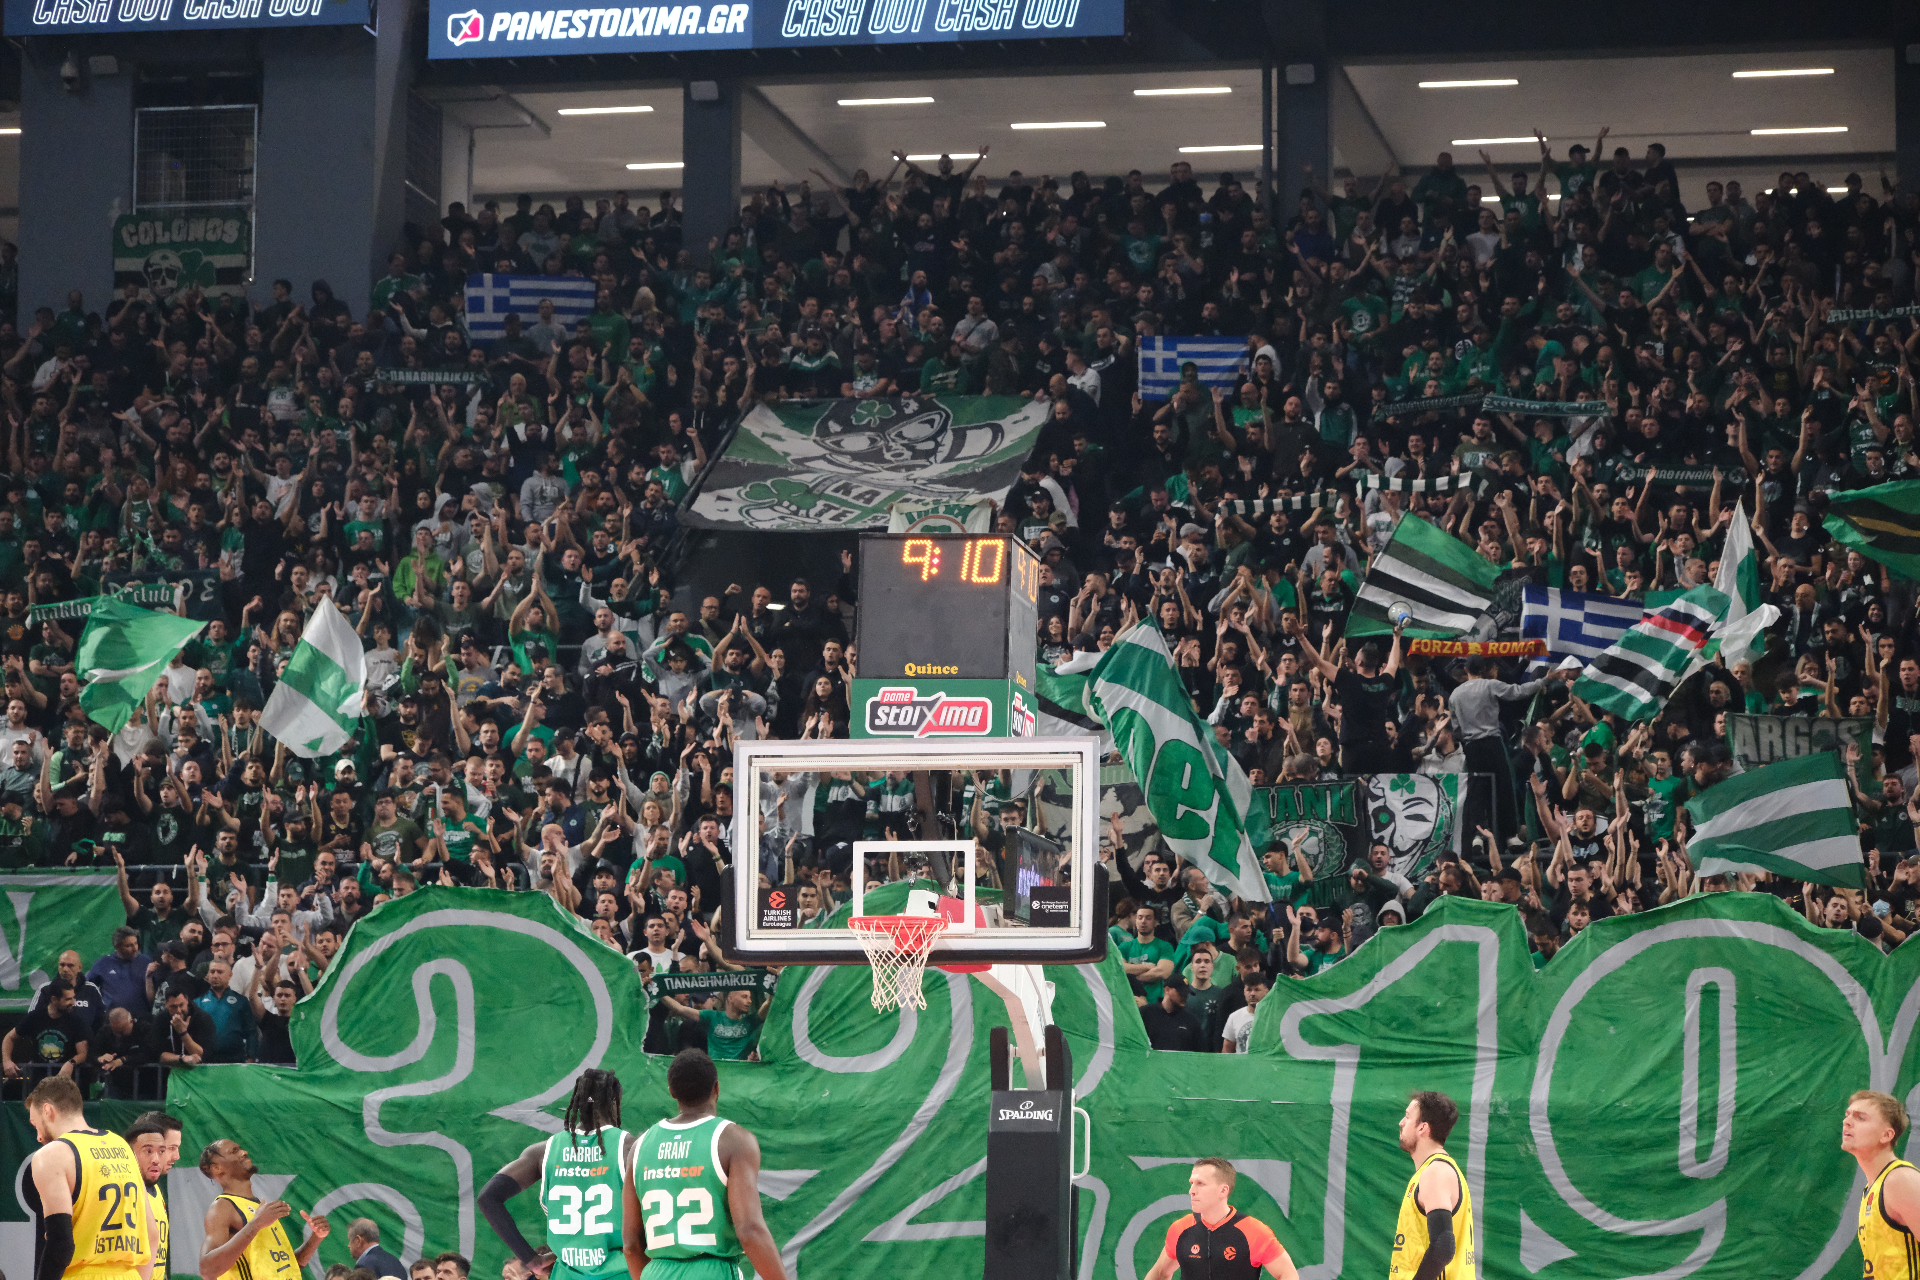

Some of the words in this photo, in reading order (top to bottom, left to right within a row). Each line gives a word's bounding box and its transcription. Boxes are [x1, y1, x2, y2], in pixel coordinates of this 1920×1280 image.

[488, 4, 749, 41] PAMESTOIXIMA.GR
[782, 0, 866, 37] CASH
[868, 0, 926, 34] OUT
[934, 0, 1018, 31] CASH
[1022, 0, 1082, 28] OUT
[121, 218, 240, 247] COLONOS
[1412, 640, 1463, 654] FORZA
[1487, 641, 1535, 655] ROMA
[904, 663, 958, 677] Quince
[883, 691, 911, 702] pame
[1734, 715, 1862, 763] ARGOS
[998, 1109, 1054, 1122] SPALDING
[657, 1140, 693, 1160] GRANT
[110, 1163, 132, 1174] MSC
[554, 1164, 610, 1177] instacar
[643, 1165, 705, 1181] instacar
[98, 1182, 138, 1232] 23
[548, 1183, 614, 1236] 32
[641, 1187, 718, 1251] 22
[561, 1247, 607, 1267] ATHENS
